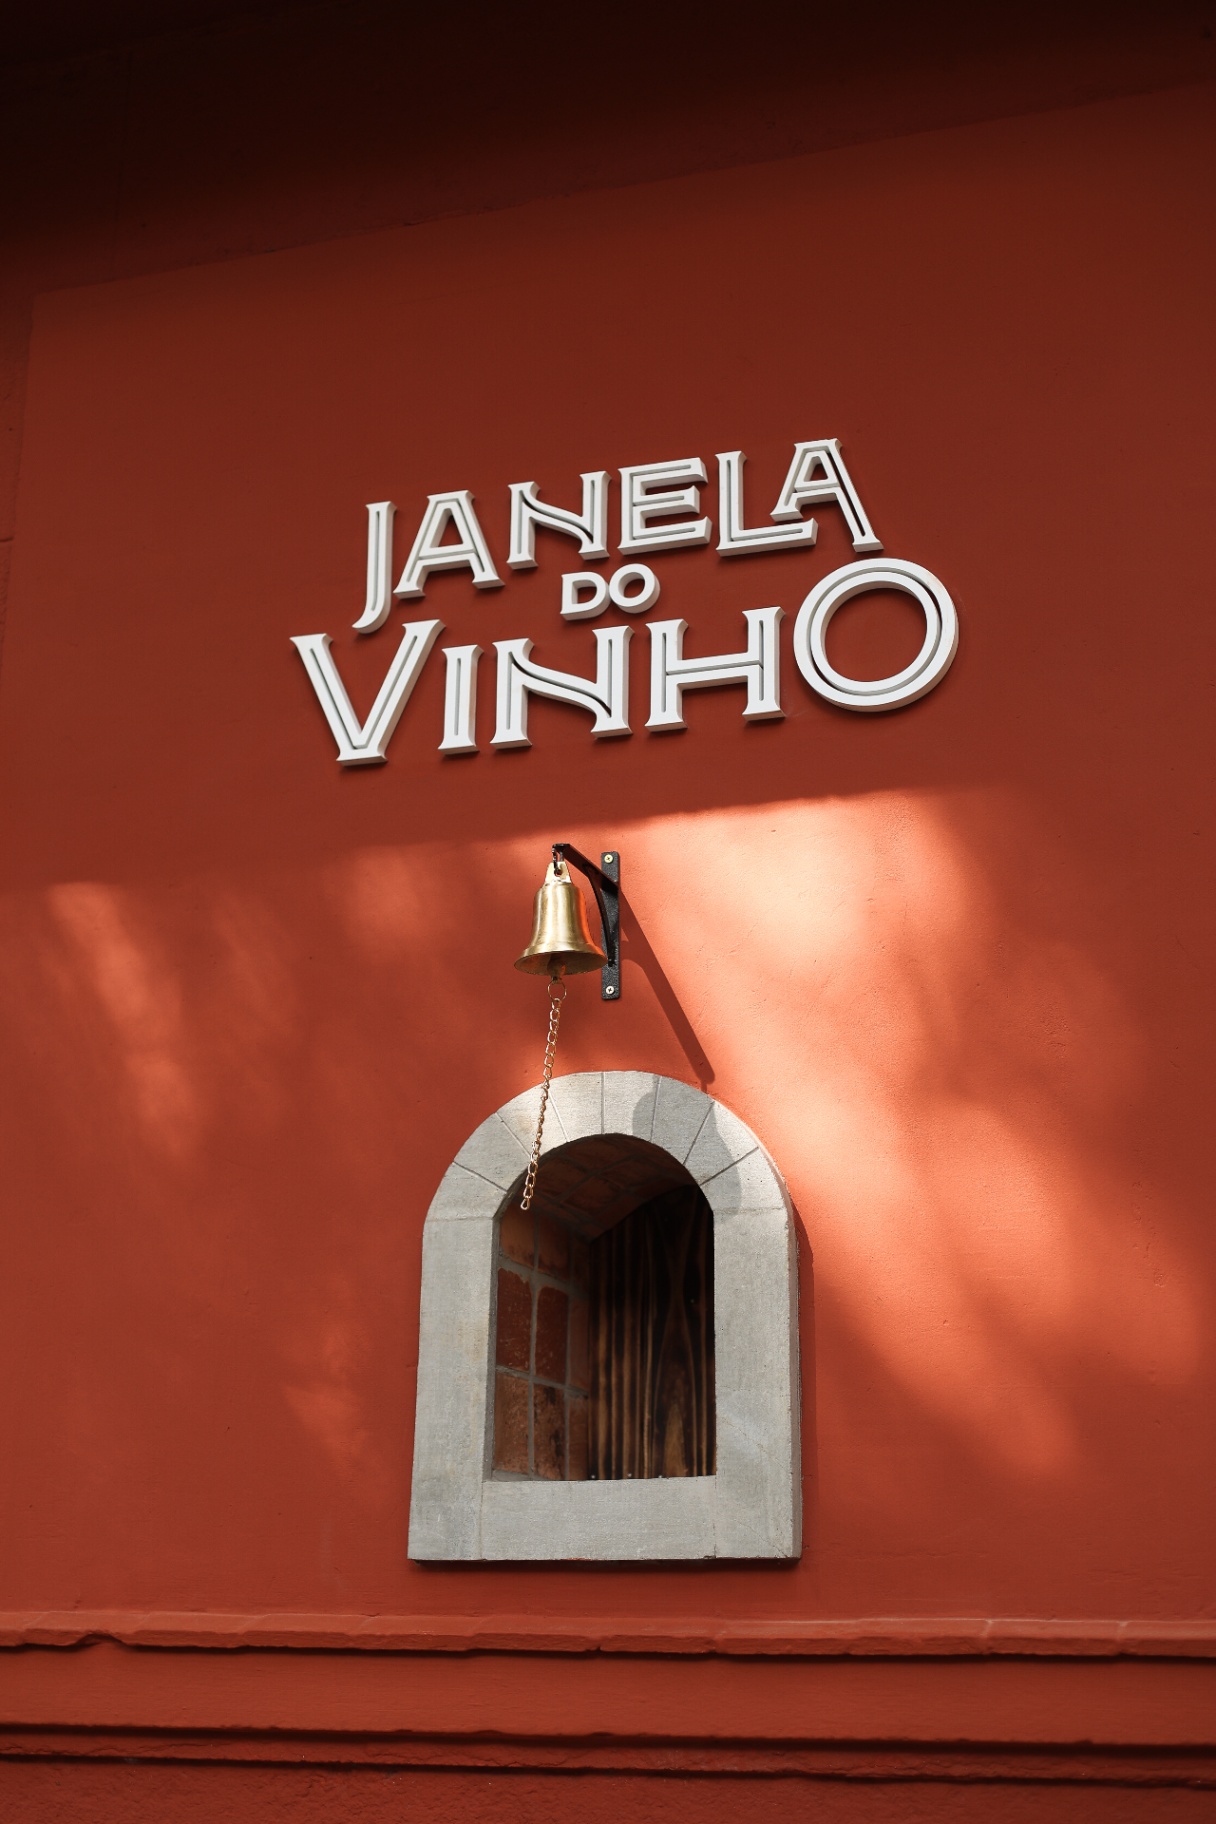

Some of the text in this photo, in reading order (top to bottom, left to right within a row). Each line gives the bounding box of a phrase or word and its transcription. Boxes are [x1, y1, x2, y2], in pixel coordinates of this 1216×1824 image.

[352, 438, 884, 633] JANELA
[559, 563, 661, 621] DO
[290, 557, 959, 766] VINHO
